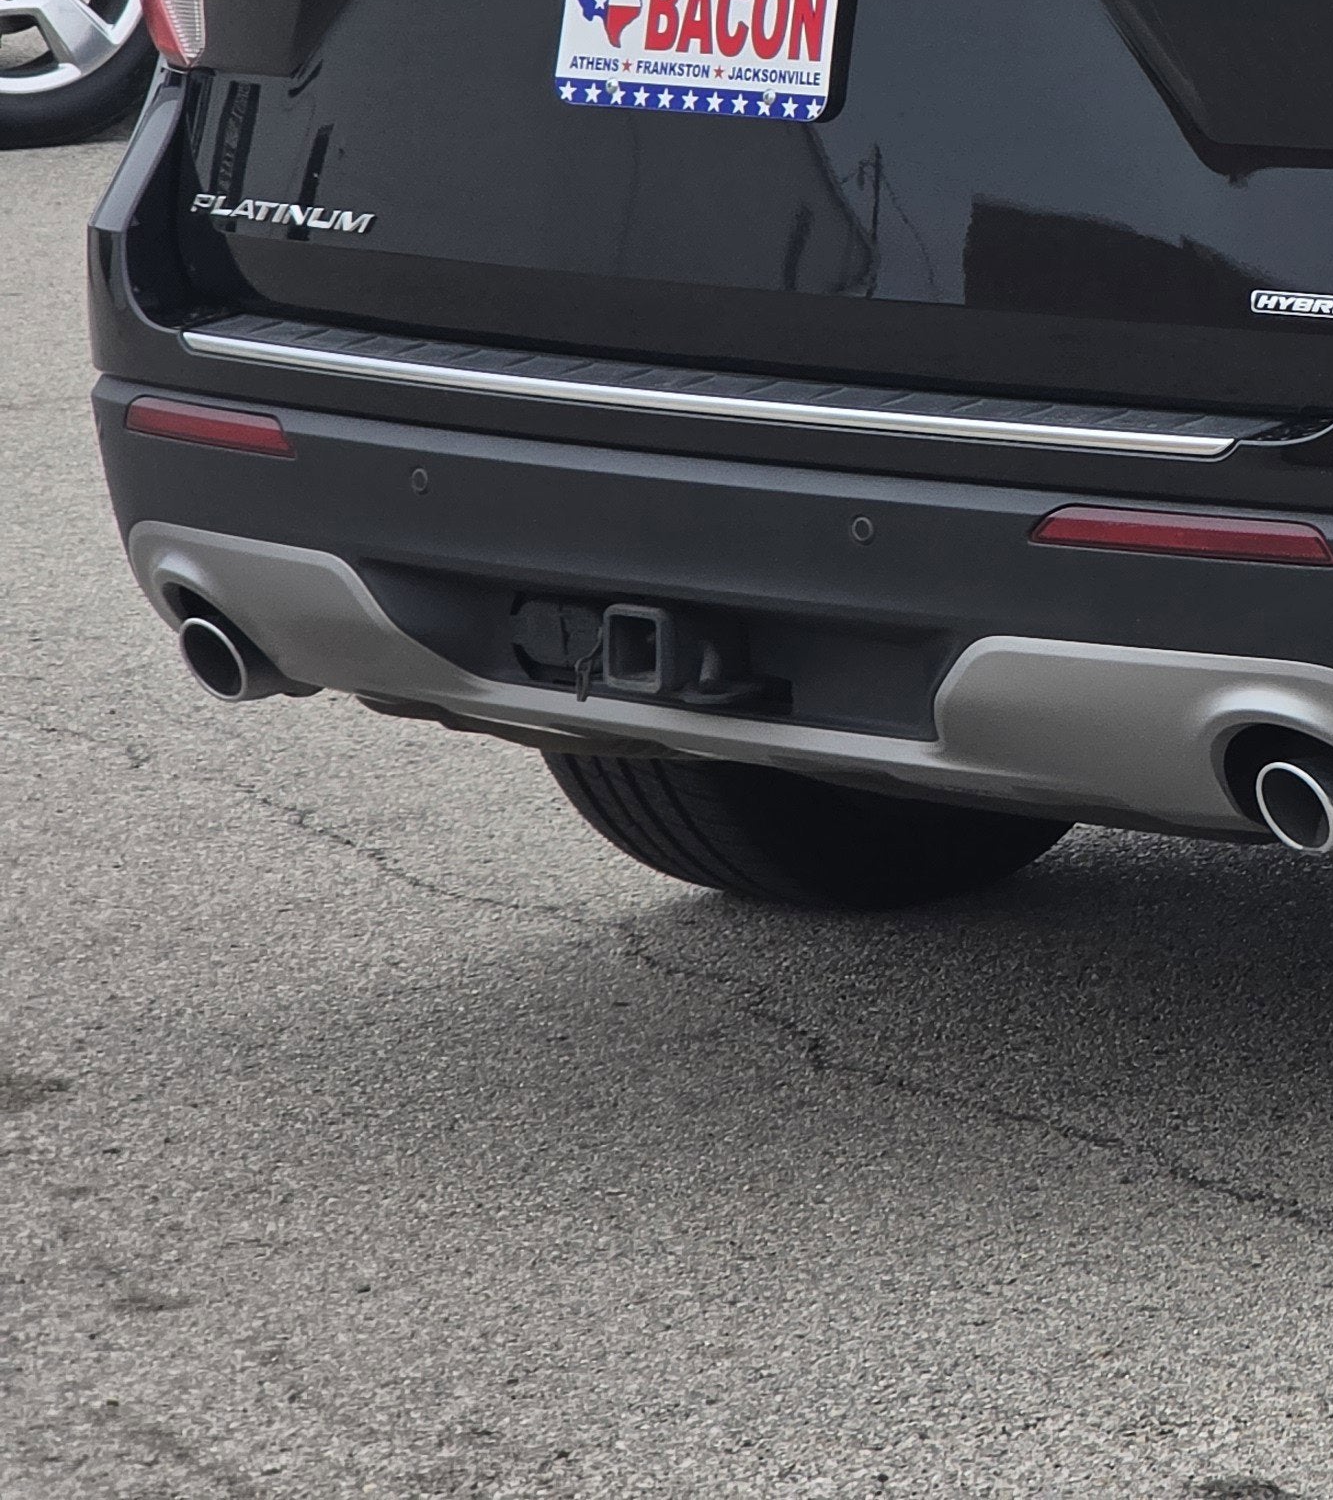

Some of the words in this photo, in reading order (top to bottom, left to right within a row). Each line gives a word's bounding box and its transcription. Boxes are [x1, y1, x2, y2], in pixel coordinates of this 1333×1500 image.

[569, 55, 620, 73] ATHENS
[635, 60, 711, 79] FRANKSTON
[727, 66, 822, 87] JACKSONVILLE
[190, 193, 376, 234] PLATINUM
